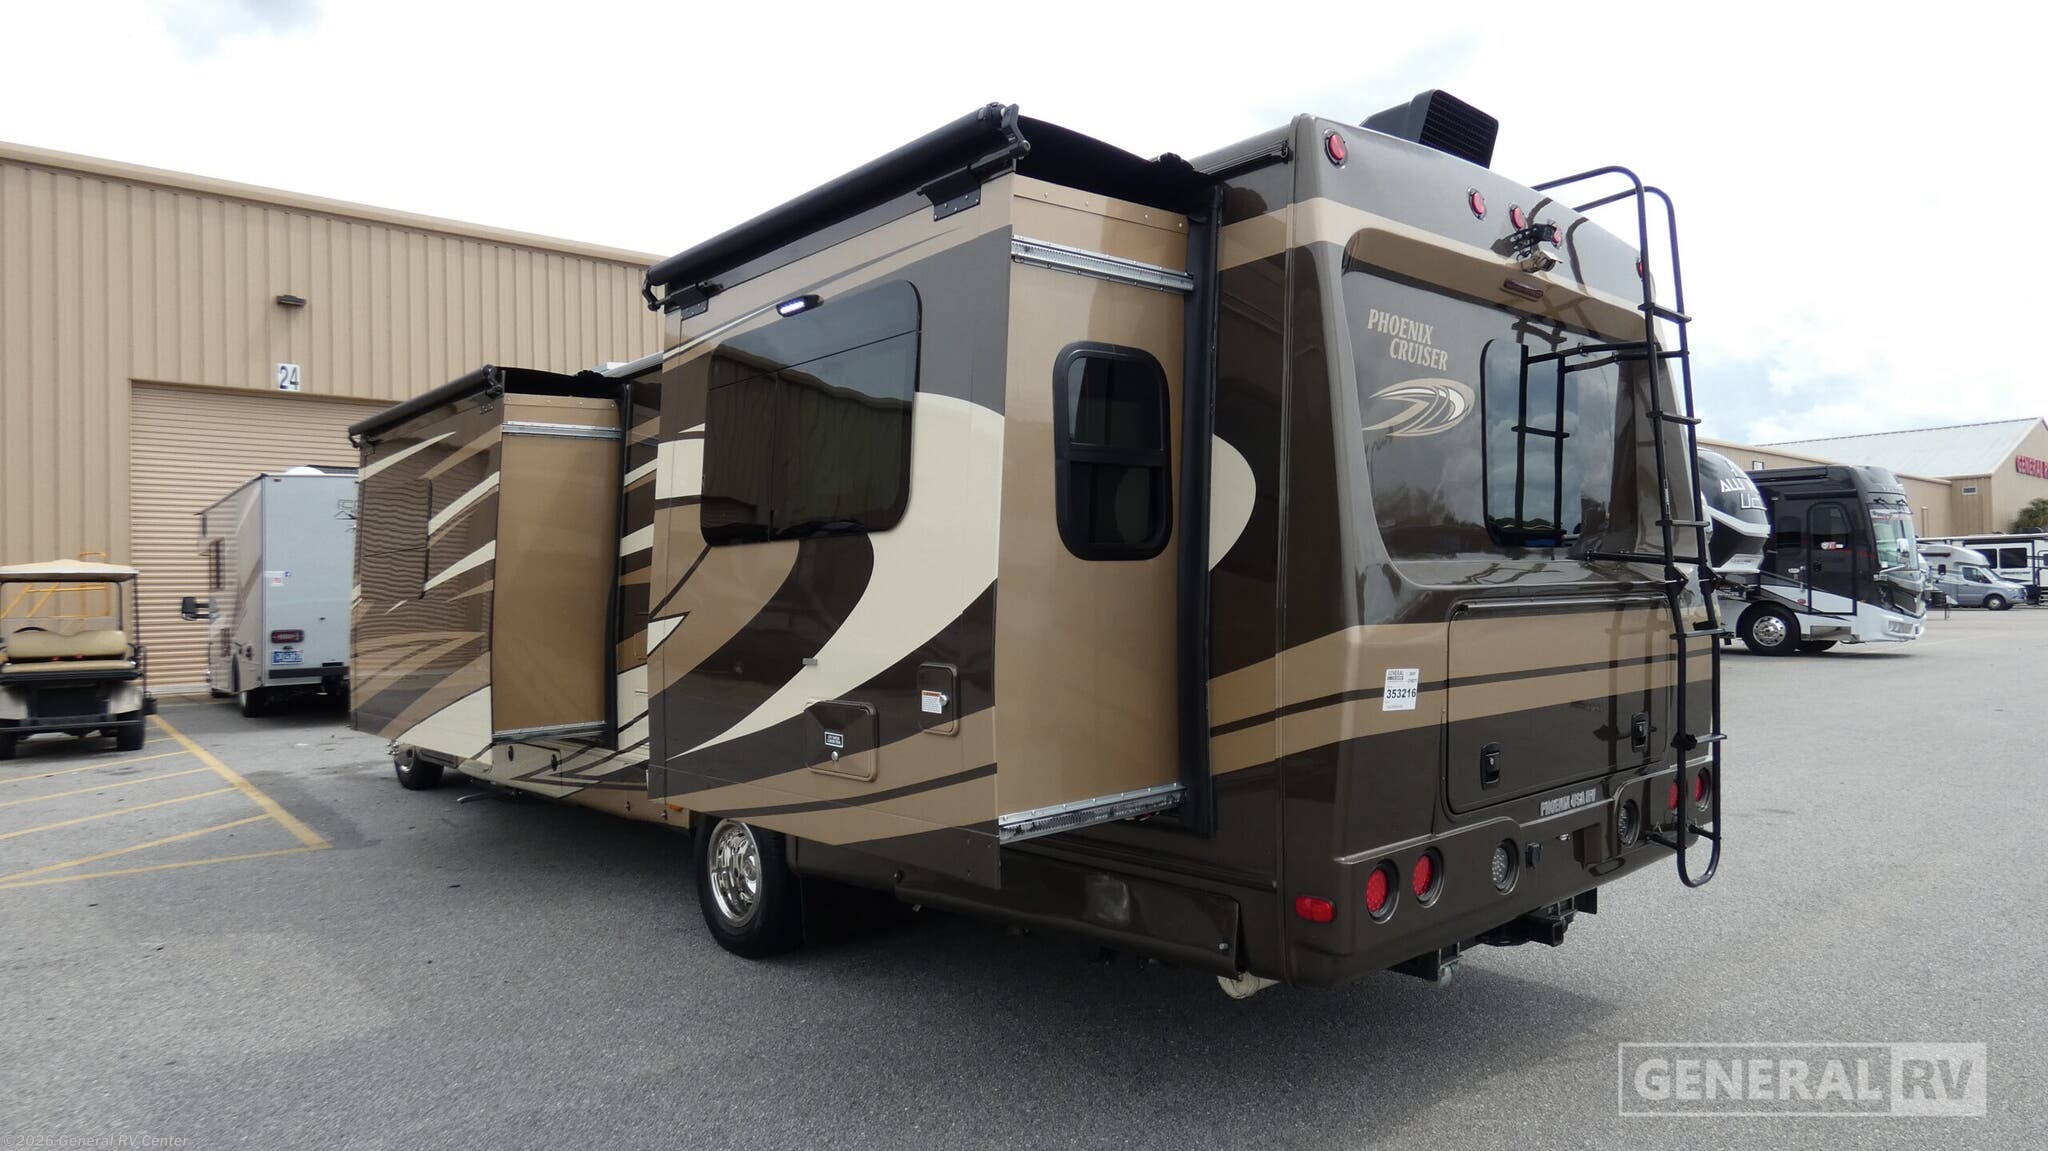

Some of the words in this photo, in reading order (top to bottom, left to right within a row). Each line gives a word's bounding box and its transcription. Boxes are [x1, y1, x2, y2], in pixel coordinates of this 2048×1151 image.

[1367, 308, 1434, 345] PHOENIX
[1390, 338, 1448, 371] CRUISER
[279, 365, 299, 390] 24
[2015, 454, 2044, 478] GENERAL
[1386, 688, 1417, 699] 353216
